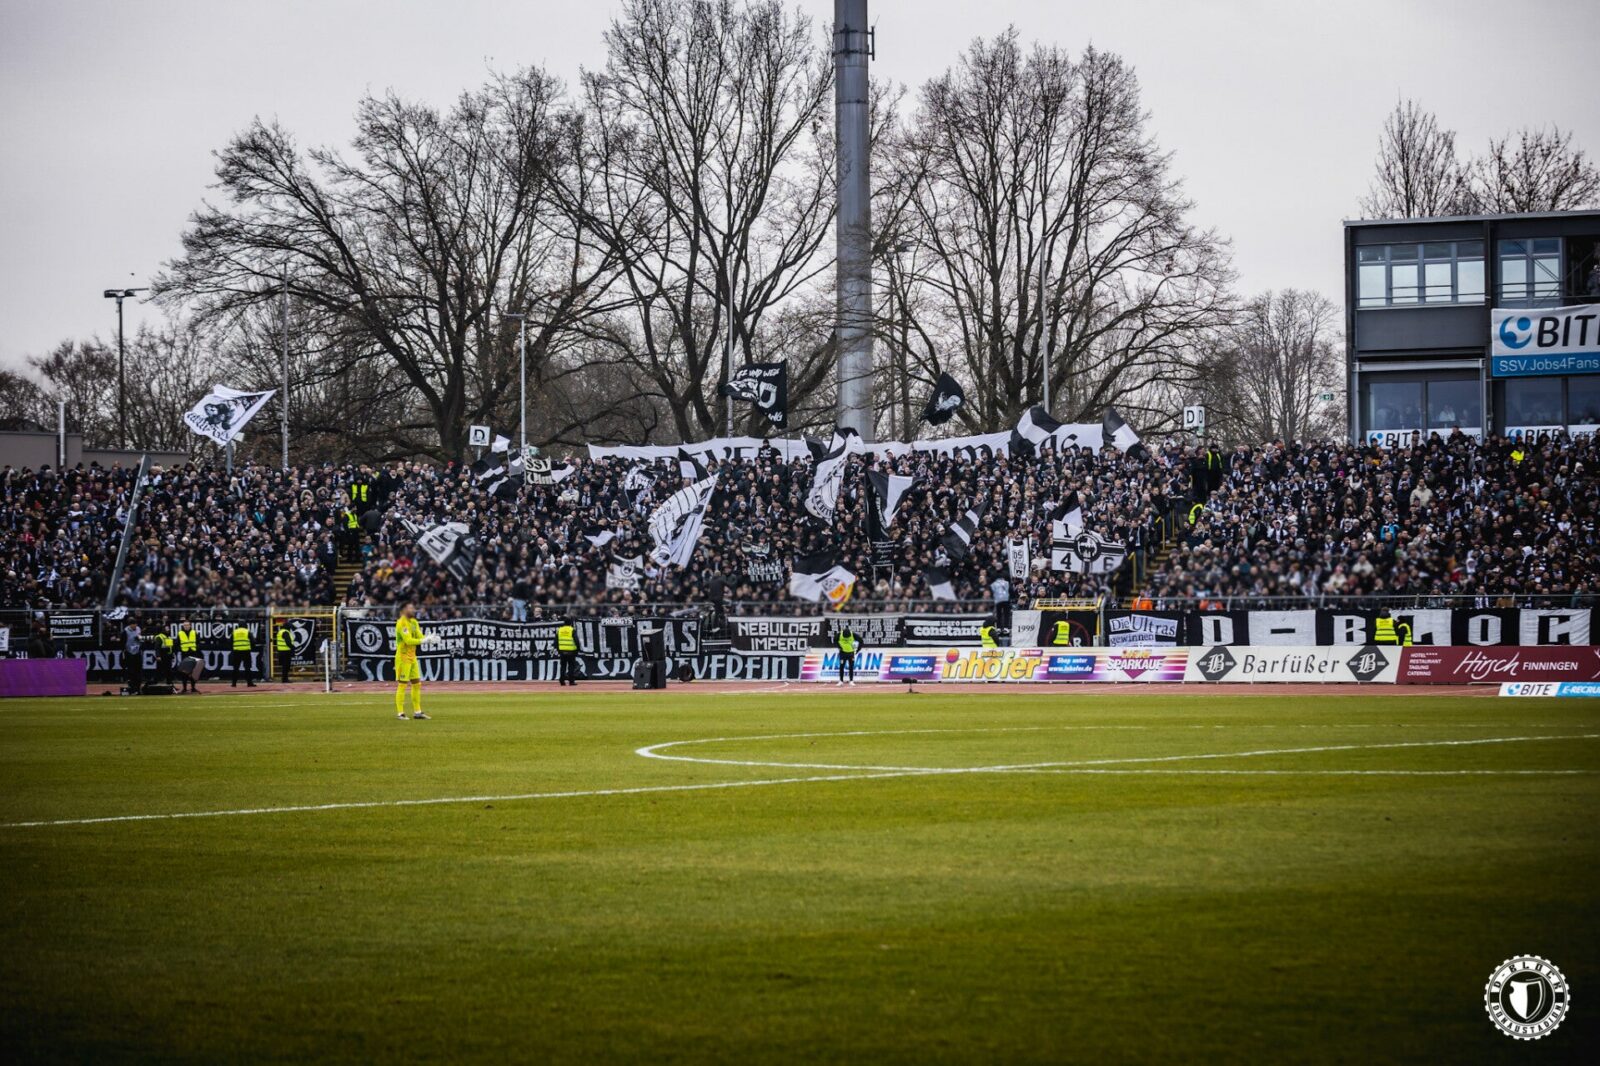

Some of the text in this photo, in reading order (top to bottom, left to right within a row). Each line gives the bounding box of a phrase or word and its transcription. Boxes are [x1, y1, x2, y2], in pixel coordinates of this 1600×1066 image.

[1537, 314, 1600, 348] BIT
[1385, 432, 1412, 449] BIT
[1063, 525, 1071, 538] 1
[1060, 553, 1072, 569] 4
[466, 624, 497, 637] FEST
[500, 626, 559, 639] ZUSAMME
[738, 622, 820, 636] NEBULOSA
[1017, 624, 1035, 633] 1999
[1111, 616, 1175, 636] Die Ultras
[468, 638, 531, 652] UNSEREN
[535, 639, 557, 651] WE
[751, 638, 808, 651] IMPERO
[1242, 654, 1340, 674] Barfüßer
[1453, 651, 1579, 680] Hirsch FINNINGEN
[1520, 684, 1552, 696] BITE
